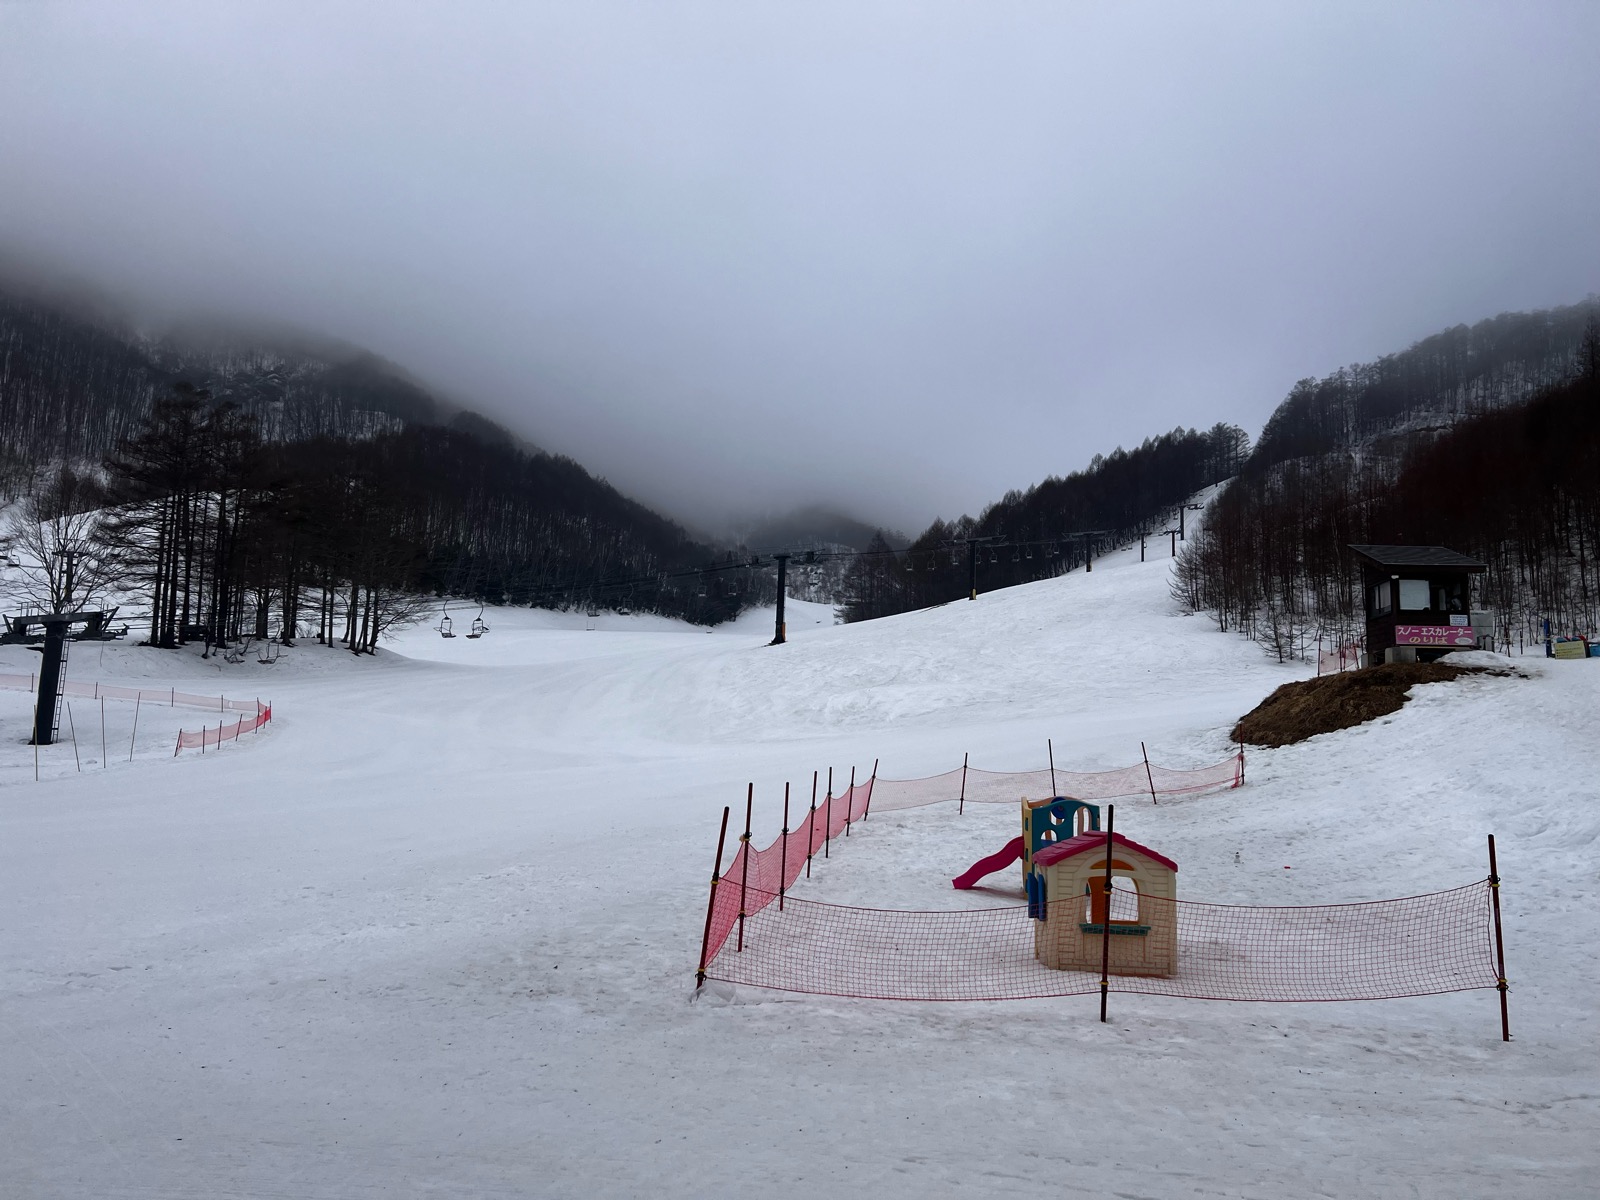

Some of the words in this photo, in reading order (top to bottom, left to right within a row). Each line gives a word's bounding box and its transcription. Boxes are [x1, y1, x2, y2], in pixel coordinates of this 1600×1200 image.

[1398, 626, 1419, 635] スノー
[1421, 627, 1472, 636] エスカレーター
[1409, 636, 1448, 644] のりば
